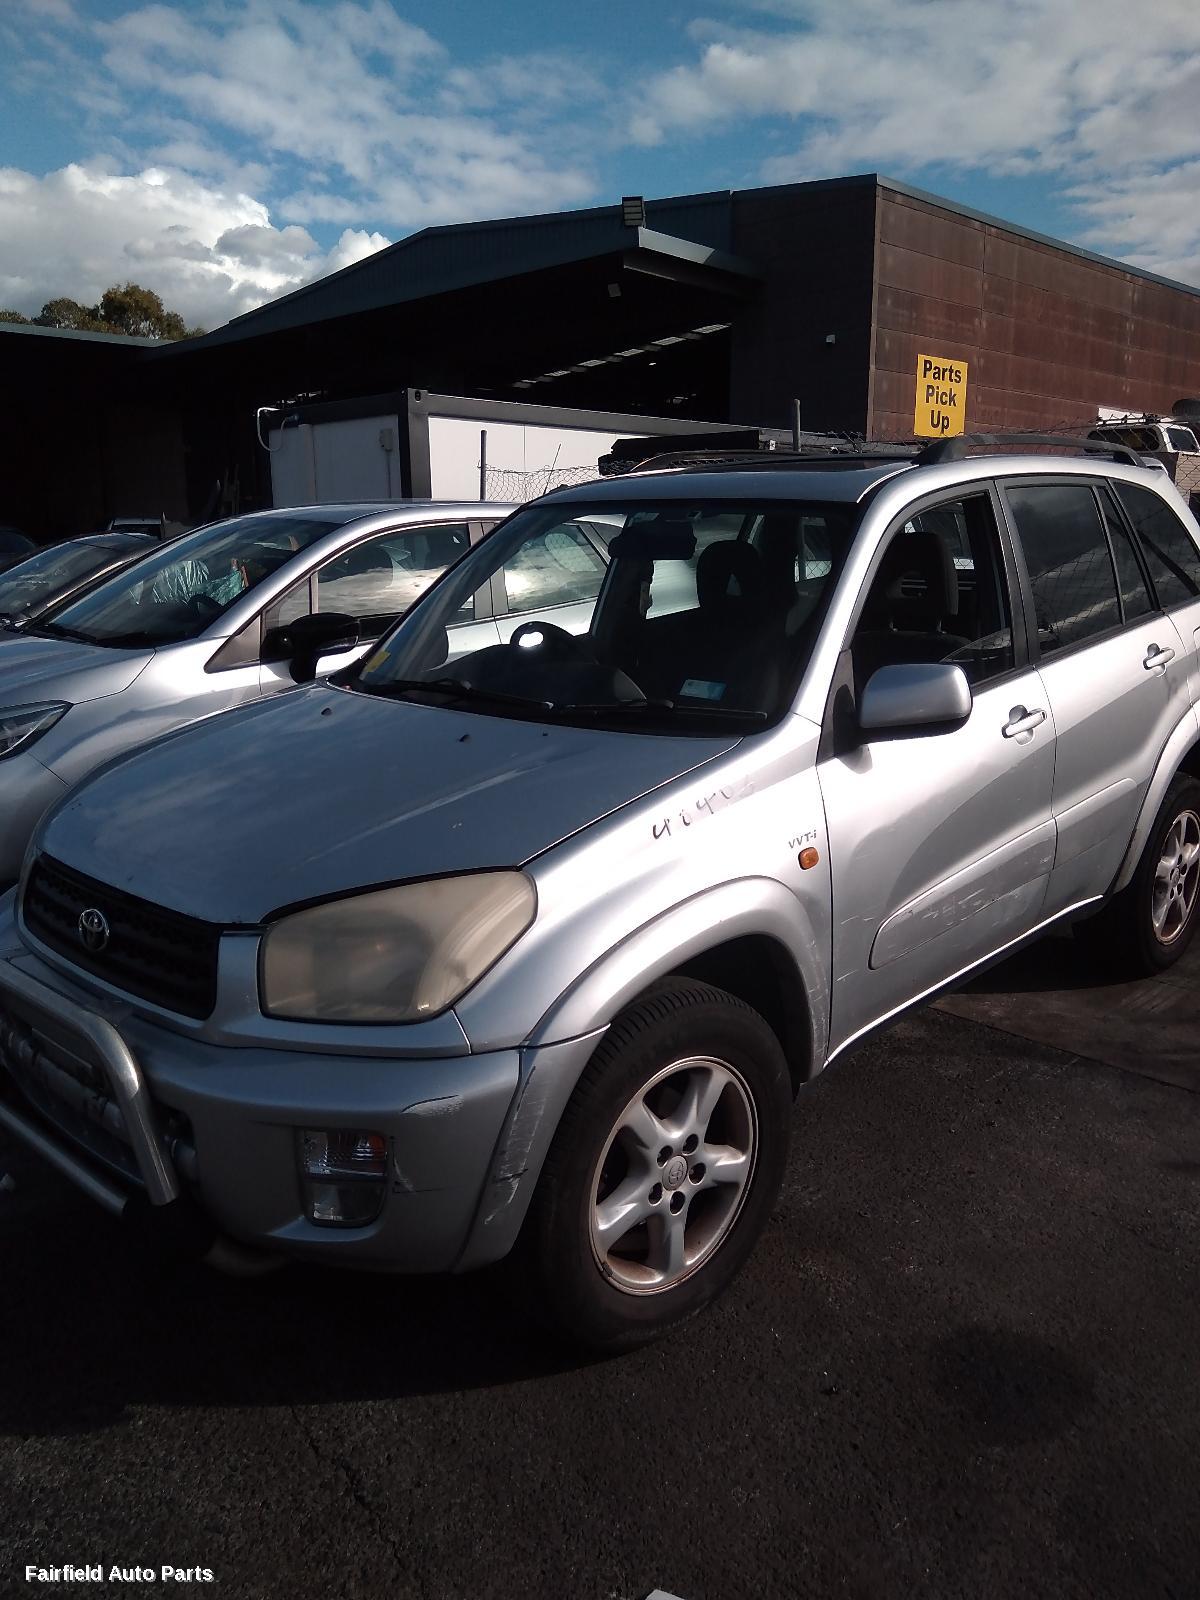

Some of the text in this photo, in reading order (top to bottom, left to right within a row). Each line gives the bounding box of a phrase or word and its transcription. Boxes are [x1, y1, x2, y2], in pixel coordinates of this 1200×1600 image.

[923, 359, 962, 384] Parts
[926, 384, 957, 407] Pick
[930, 409, 950, 434] Up
[788, 829, 817, 849] VVT-i
